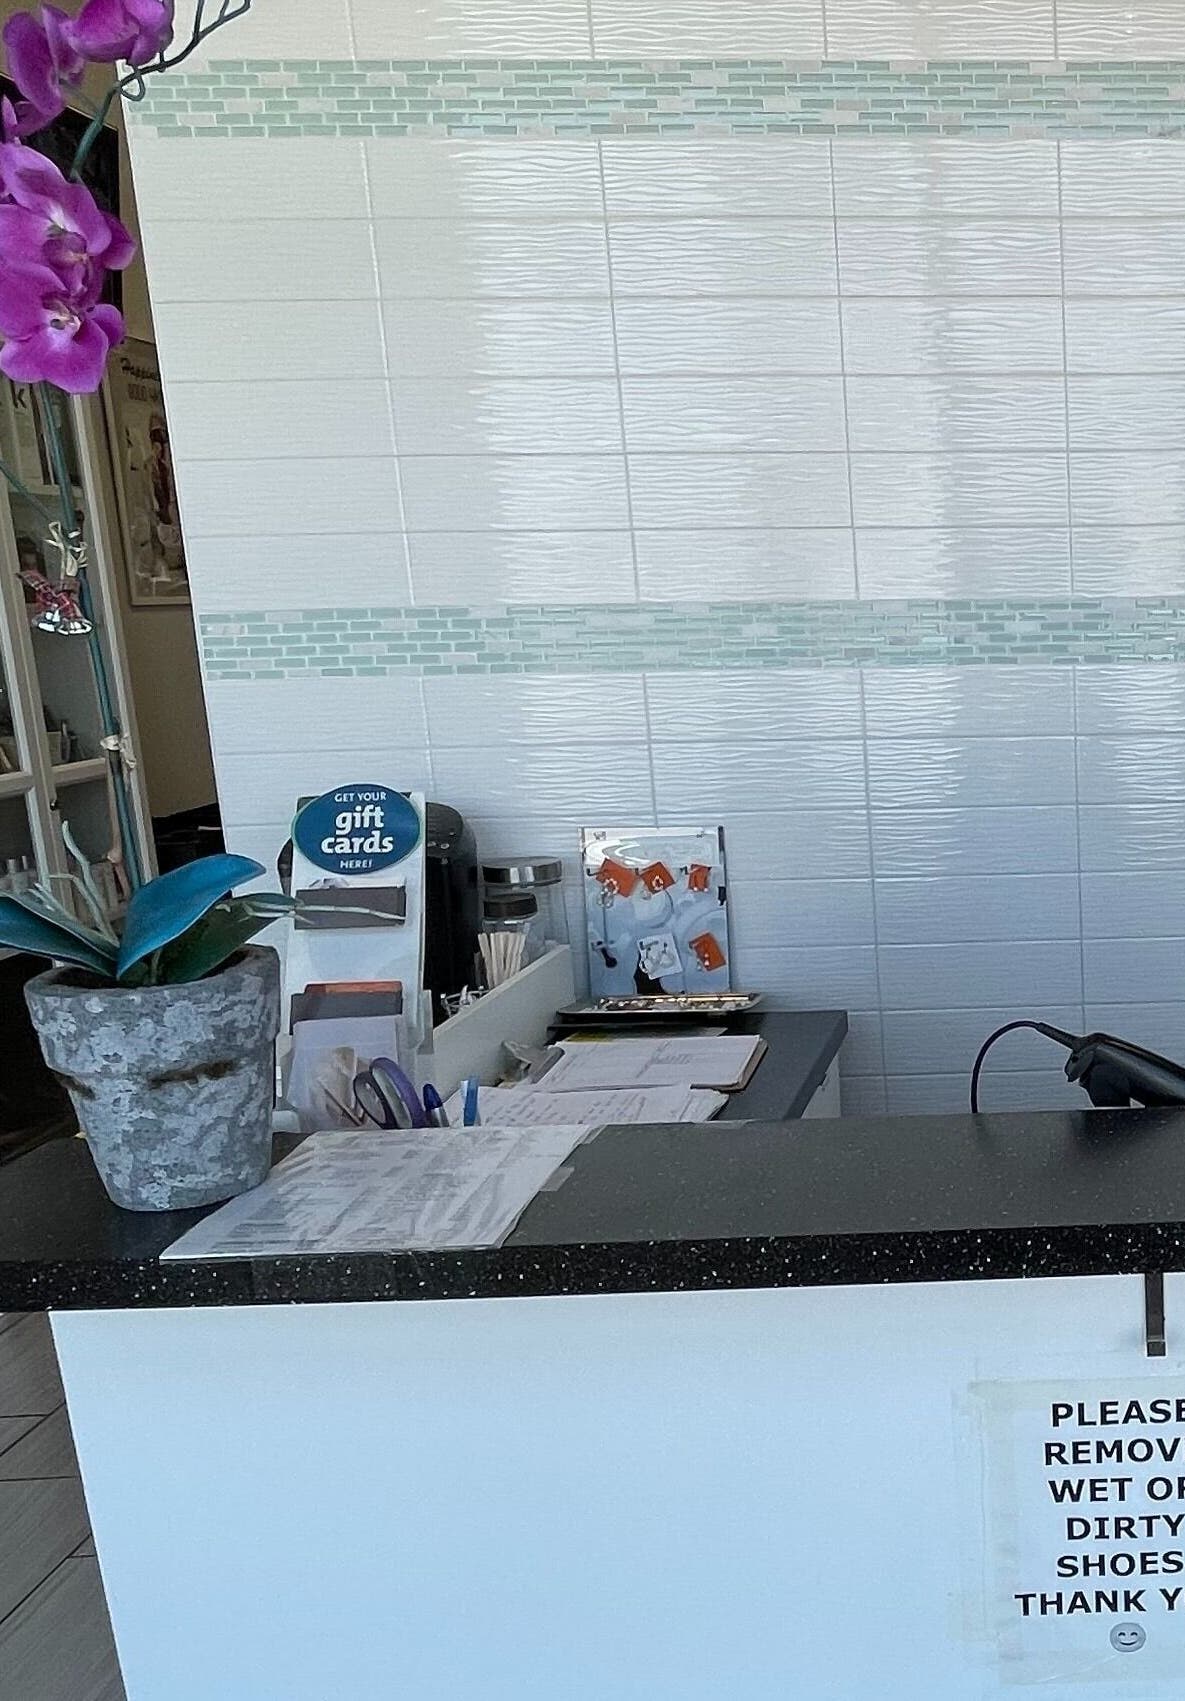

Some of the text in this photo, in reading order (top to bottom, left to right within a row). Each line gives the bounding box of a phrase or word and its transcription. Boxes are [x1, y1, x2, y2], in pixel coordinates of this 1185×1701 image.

[334, 791, 387, 803] GET YOUR
[335, 804, 385, 836] gift
[321, 829, 394, 854] cards
[339, 859, 373, 869] HERE!
[1047, 1477, 1133, 1503] WET
[1066, 1513, 1185, 1541] DIRTY
[1014, 1589, 1147, 1617] THANK
